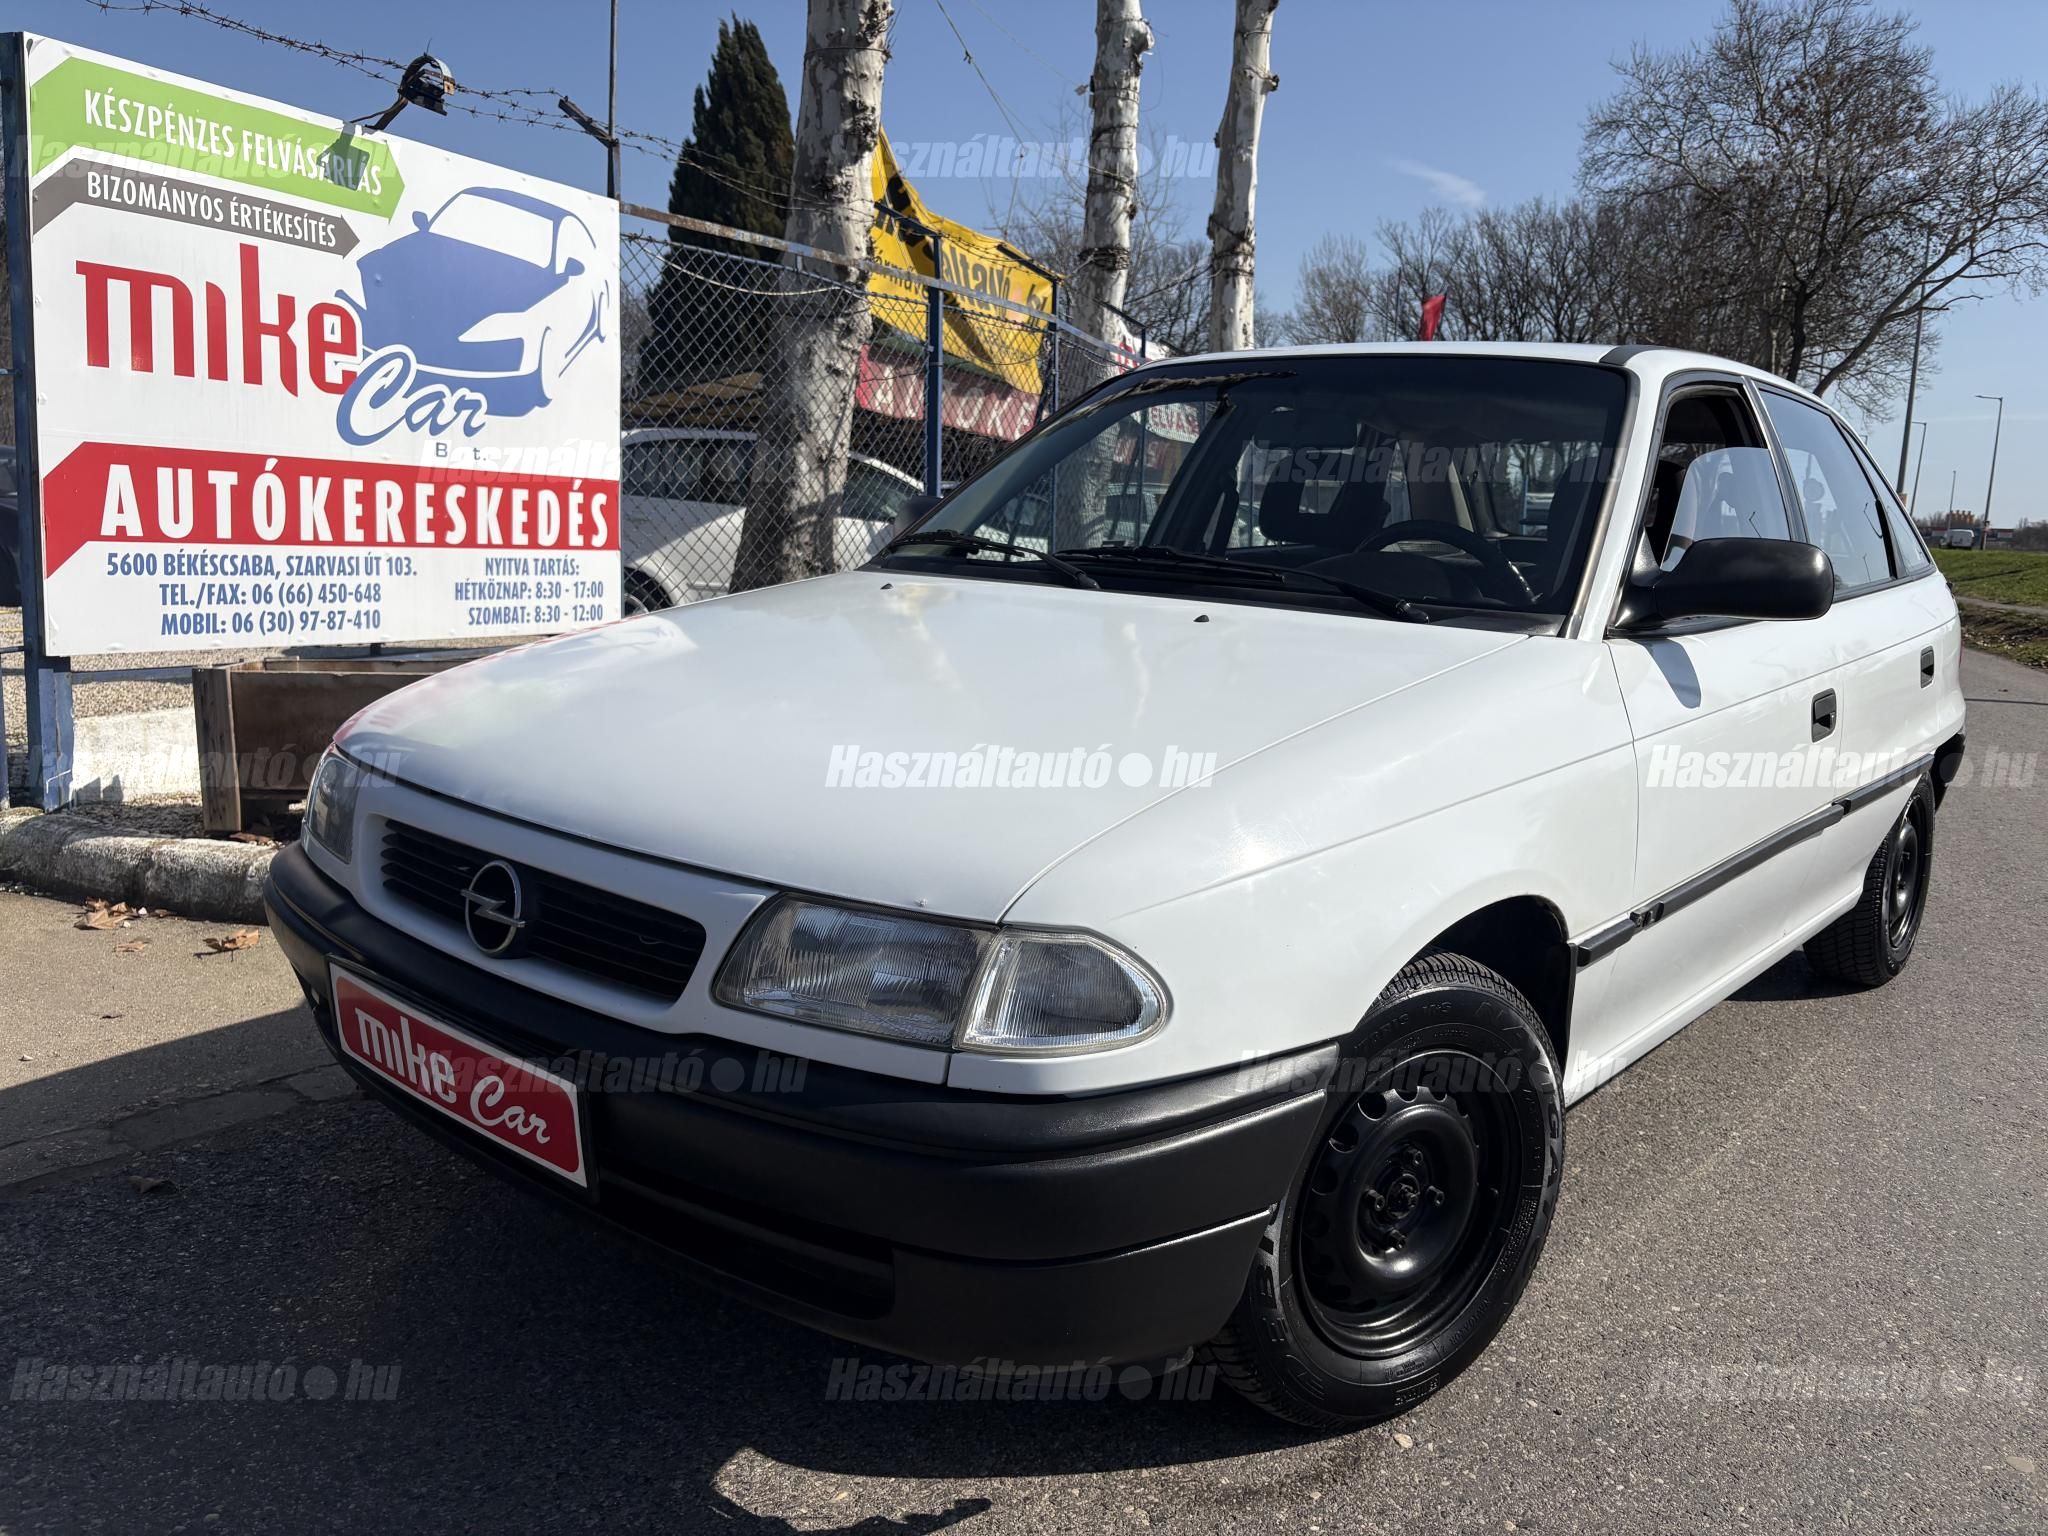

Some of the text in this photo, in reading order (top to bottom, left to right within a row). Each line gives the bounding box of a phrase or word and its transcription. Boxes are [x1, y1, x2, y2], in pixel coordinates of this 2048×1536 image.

[84, 87, 383, 197] KÉSZPÉNZES FELVÁSÁRLÁS
[87, 171, 336, 248] BIZOMÁNYOS ÉRTÉKESÍTÉS
[76, 243, 358, 397] mike
[336, 349, 487, 446] Car
[99, 458, 609, 548] AUTÓKERESKEDÉS
[107, 548, 418, 580] 5600 BÉKÉSCSABA, SZARVASI ÚT 103.
[455, 577, 533, 601] HÉTKÖZNAP:
[535, 581, 562, 599] 8:30
[573, 580, 604, 599] 17:00
[485, 555, 580, 577] NYITVA TARTÁS:
[159, 582, 382, 609] TEL./FAX: 06 (66) 450-648
[160, 608, 382, 636] MOBIL: 06 (30) 97-87-410
[468, 605, 531, 627] SZOMBAT:
[534, 604, 561, 624] 8:30
[572, 602, 604, 622] 12:00
[355, 1007, 551, 1145] mike Car
